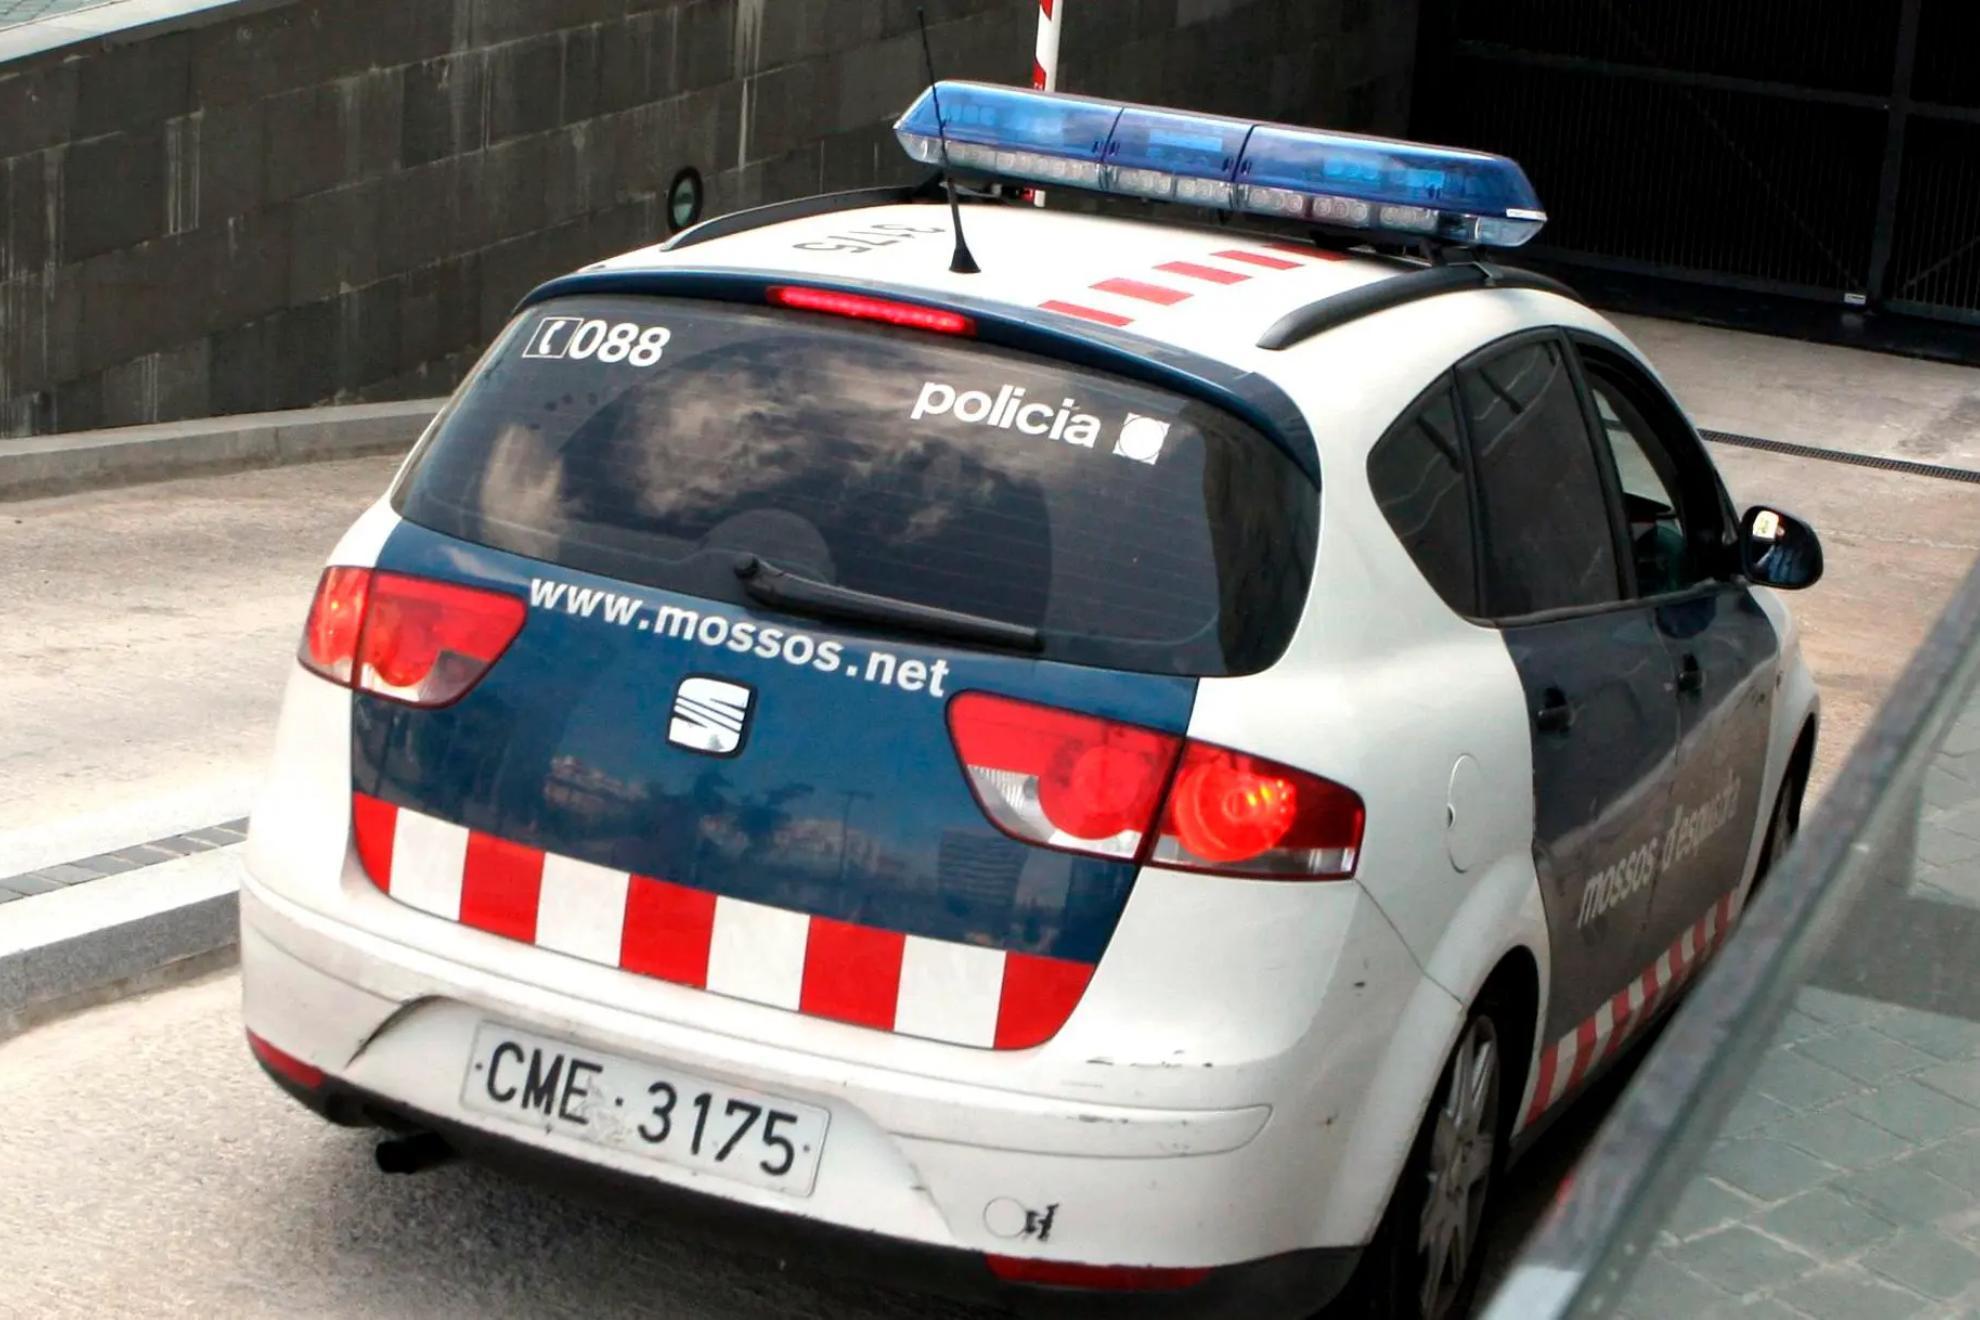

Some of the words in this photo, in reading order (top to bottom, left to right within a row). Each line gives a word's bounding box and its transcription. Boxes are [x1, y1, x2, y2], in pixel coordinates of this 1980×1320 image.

[568, 319, 671, 367] 088
[910, 381, 1101, 448] policia
[529, 577, 950, 698] www.mossos.net
[1577, 836, 1660, 929] mossos
